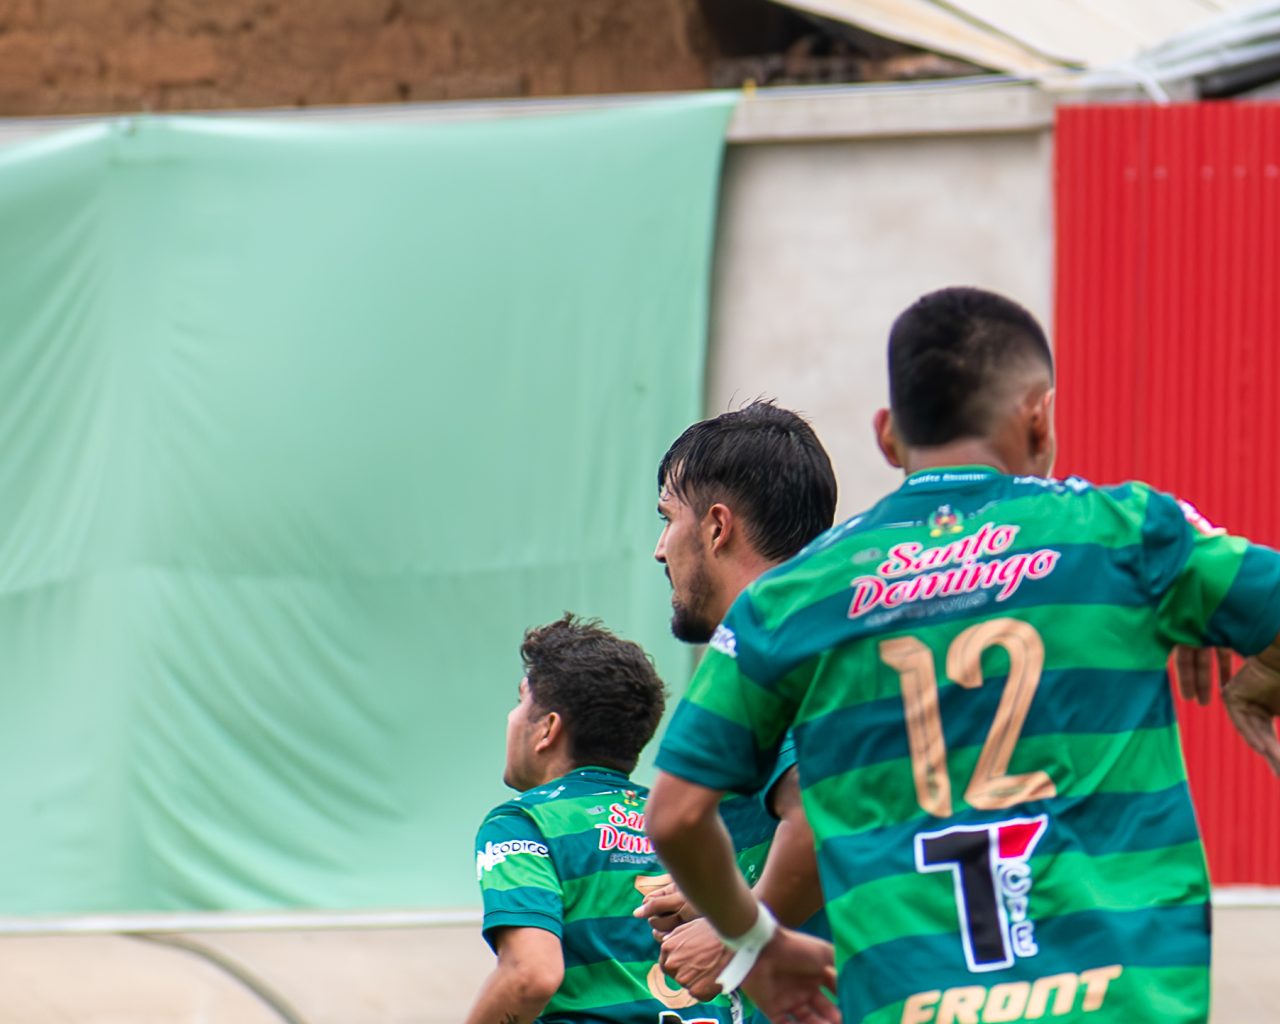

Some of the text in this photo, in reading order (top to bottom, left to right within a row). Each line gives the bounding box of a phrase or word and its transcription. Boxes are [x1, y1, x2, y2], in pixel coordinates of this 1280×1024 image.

[848, 549, 1061, 619] Domingo
[877, 522, 1020, 577] Santo
[878, 617, 1058, 818] 12
